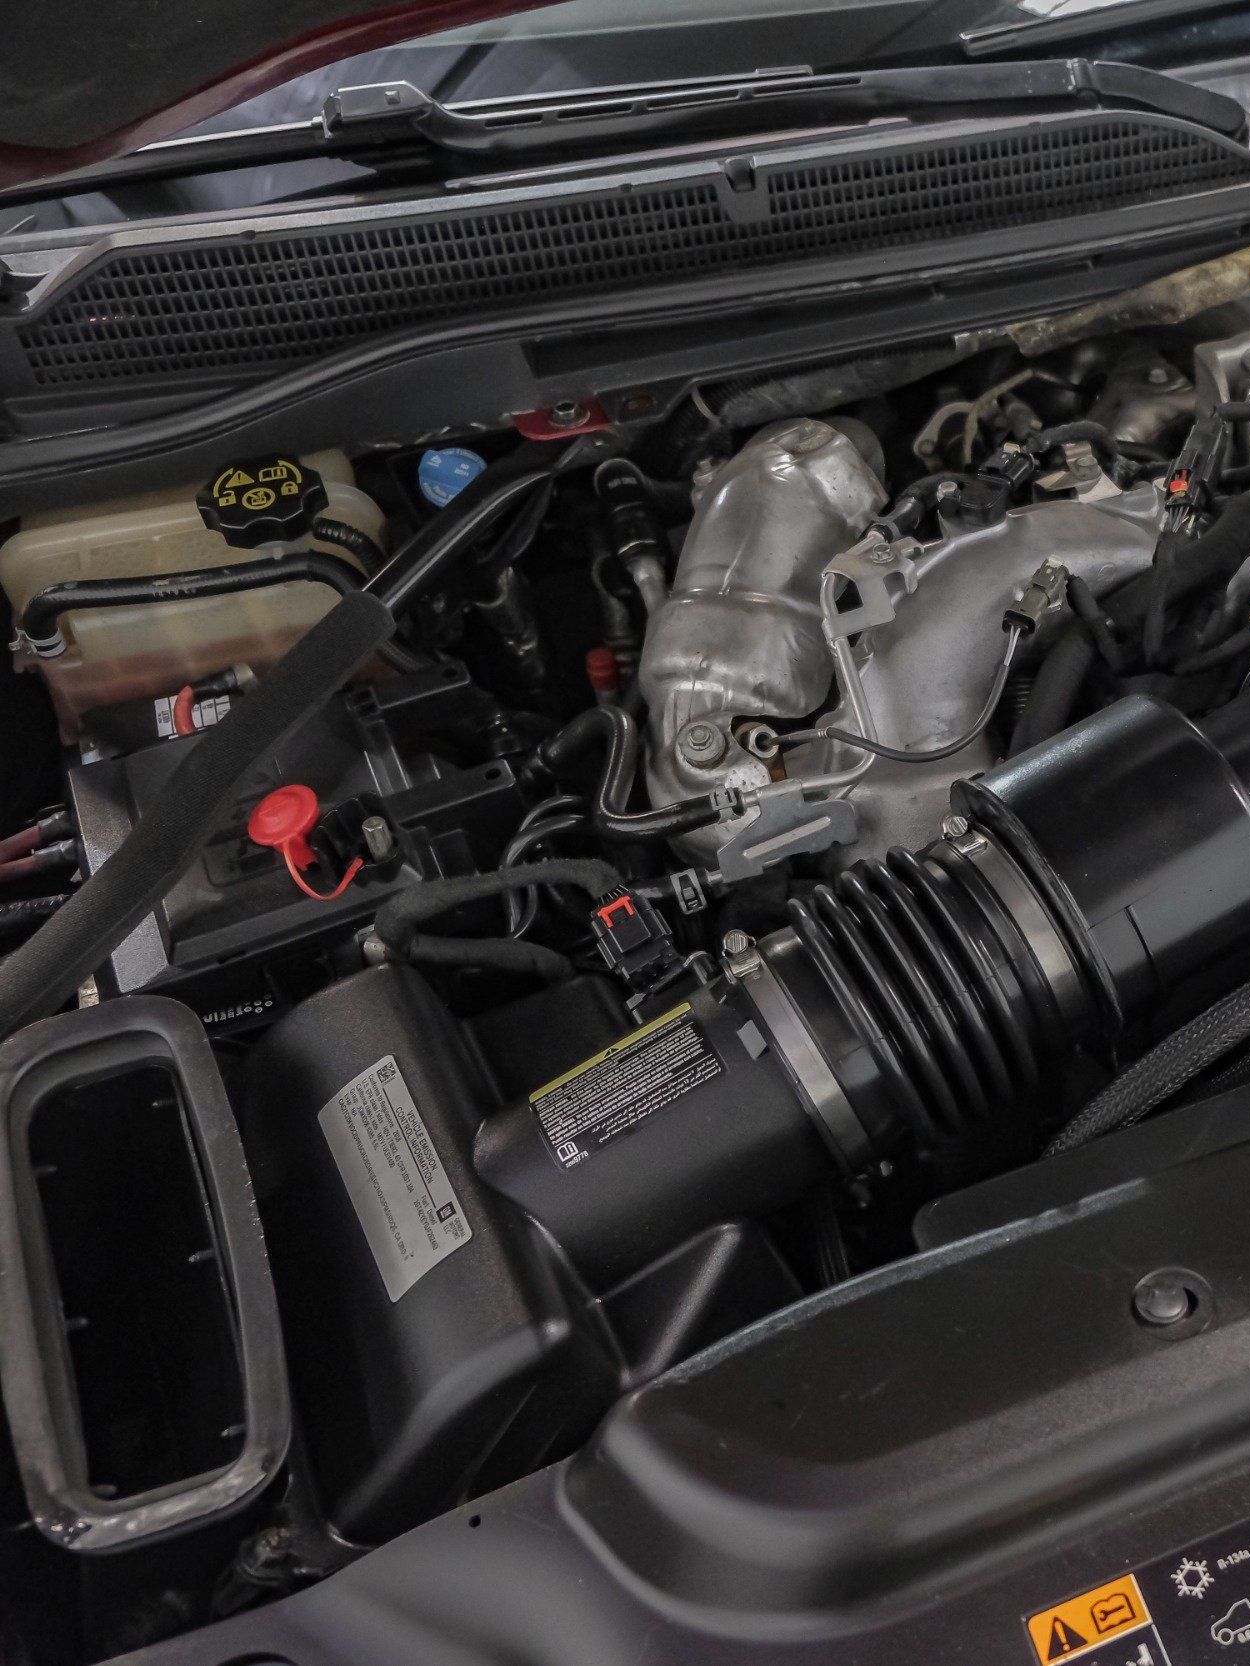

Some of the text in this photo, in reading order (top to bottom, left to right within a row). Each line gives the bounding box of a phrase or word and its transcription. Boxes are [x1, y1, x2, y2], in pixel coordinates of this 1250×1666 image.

[395, 1105, 434, 1185] CONTROL INFORMATION
[406, 1109, 438, 1172] VEHICLE EMISSION
